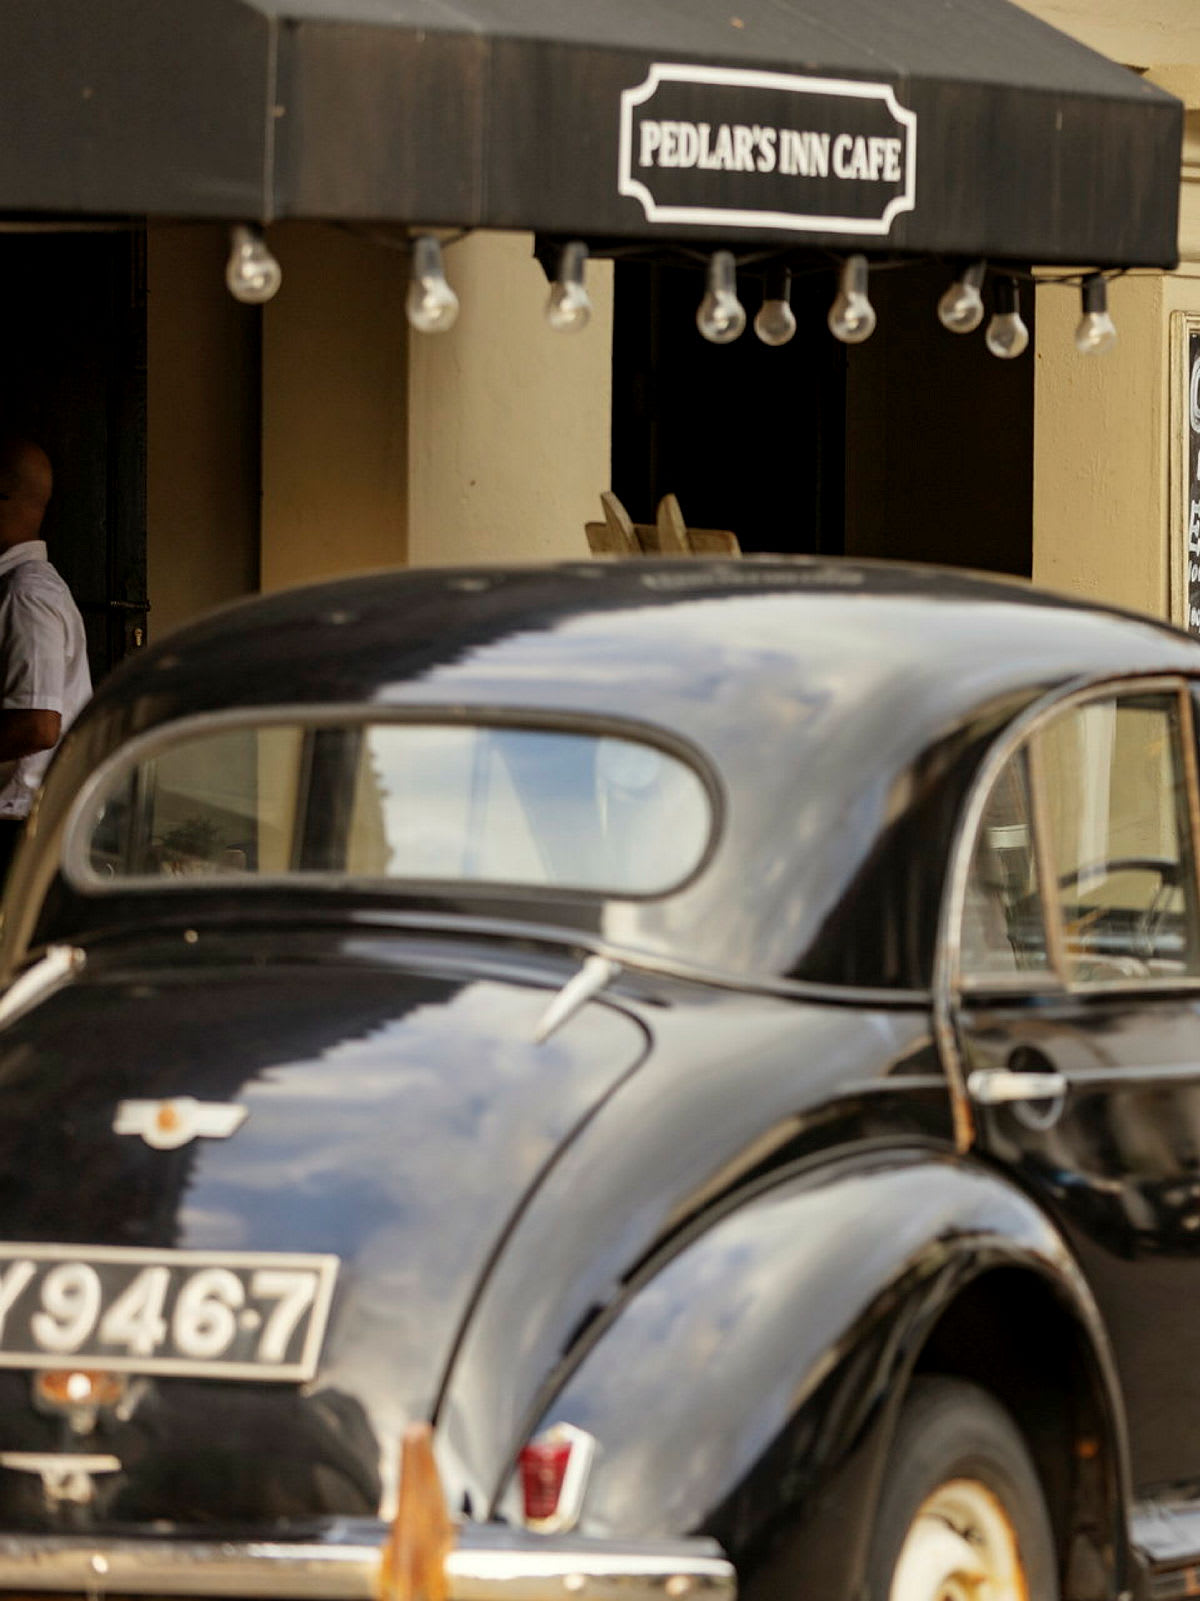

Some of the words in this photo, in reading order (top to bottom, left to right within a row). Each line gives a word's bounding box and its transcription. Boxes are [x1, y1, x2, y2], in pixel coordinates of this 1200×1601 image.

[639, 120, 777, 172] PEDLAR'S
[779, 128, 830, 177] INN
[833, 133, 902, 182] CAFE
